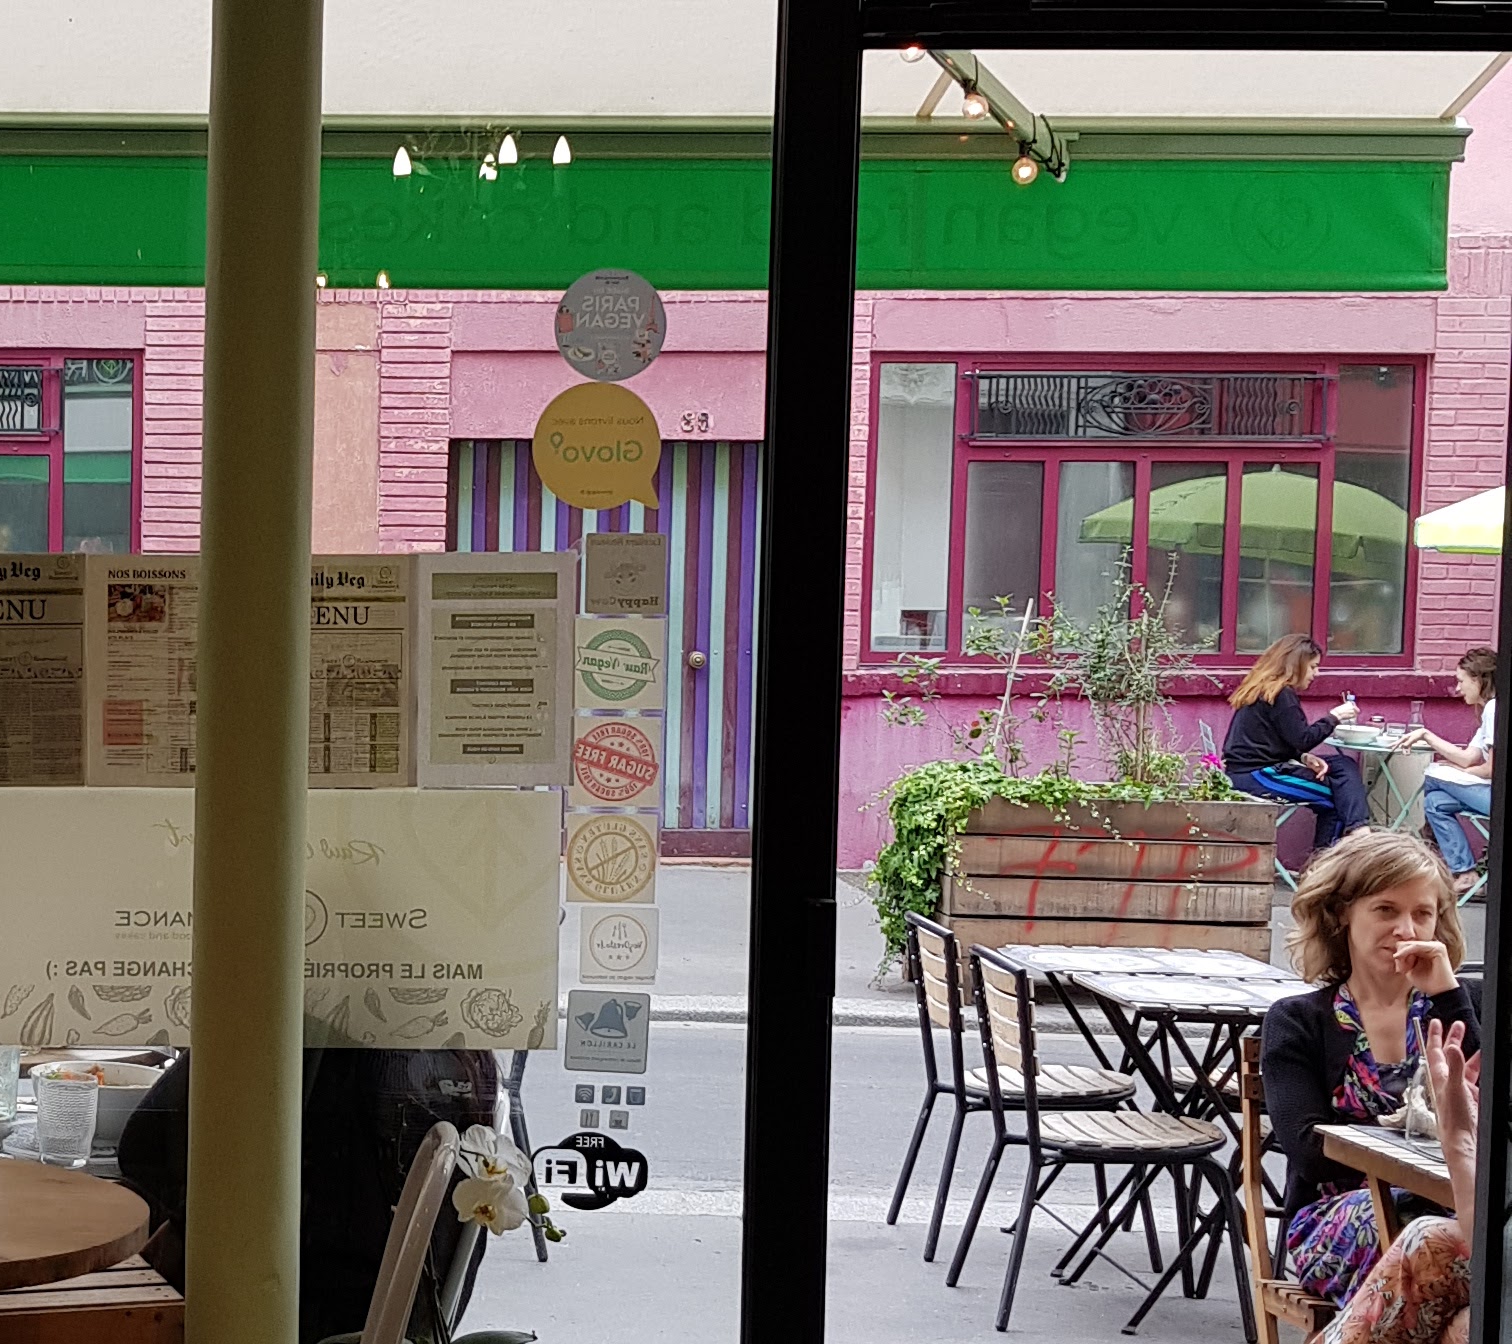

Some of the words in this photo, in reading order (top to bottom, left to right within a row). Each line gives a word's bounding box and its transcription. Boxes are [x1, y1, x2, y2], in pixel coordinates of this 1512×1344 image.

[107, 569, 130, 579] NOS
[133, 569, 187, 579] BOISSONS
[311, 571, 334, 589] ily
[312, 605, 370, 626] ENU
